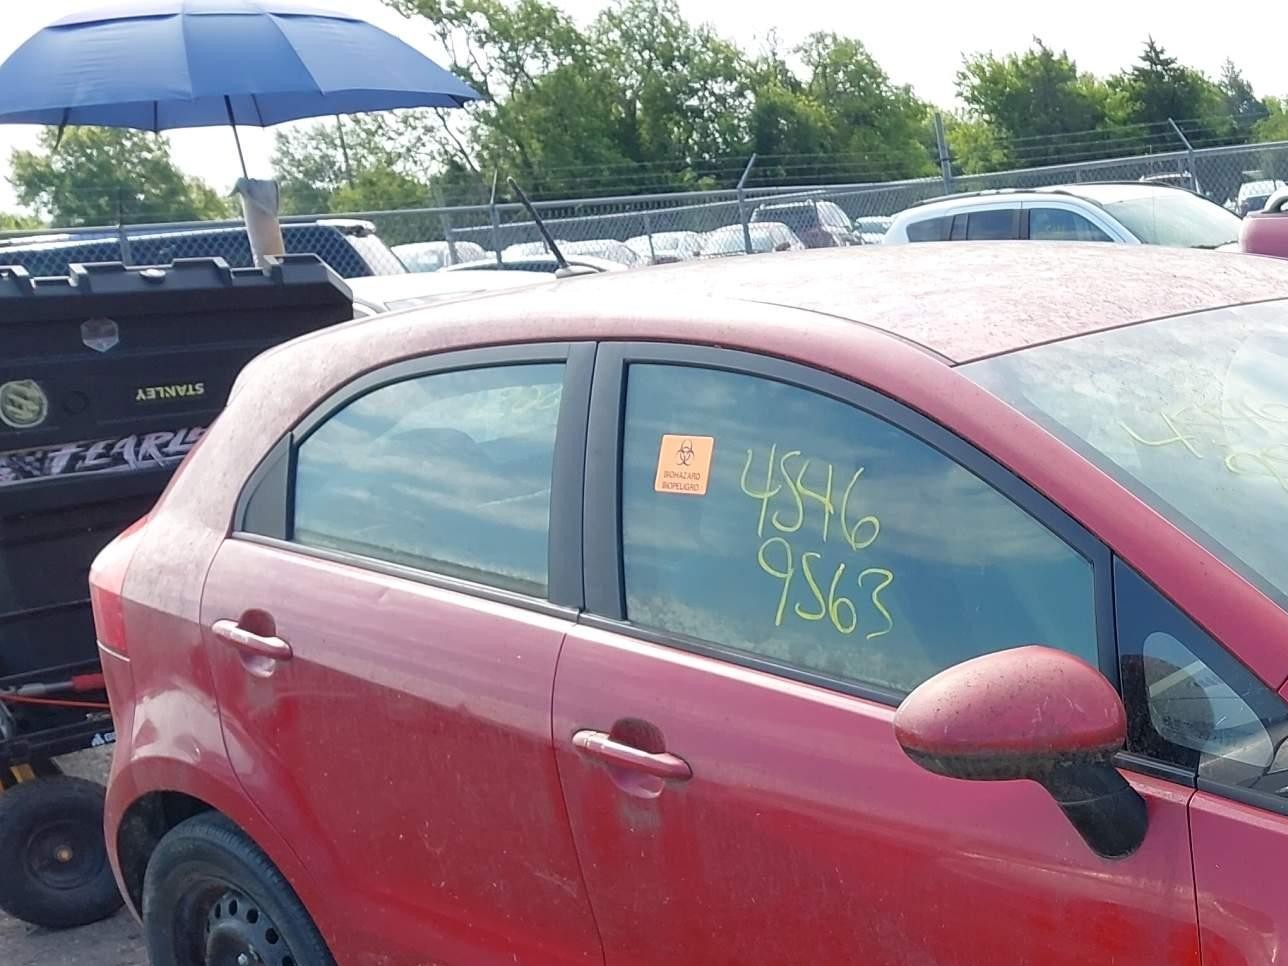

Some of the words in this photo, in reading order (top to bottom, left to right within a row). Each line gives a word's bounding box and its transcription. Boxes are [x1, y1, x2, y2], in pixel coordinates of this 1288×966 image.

[135, 382, 205, 401] STANLEY
[663, 470, 701, 481] BIOHAZARD
[662, 481, 700, 492] BIOPELIGRO
[740, 443, 880, 550] 4546
[757, 536, 894, 640] 9563
